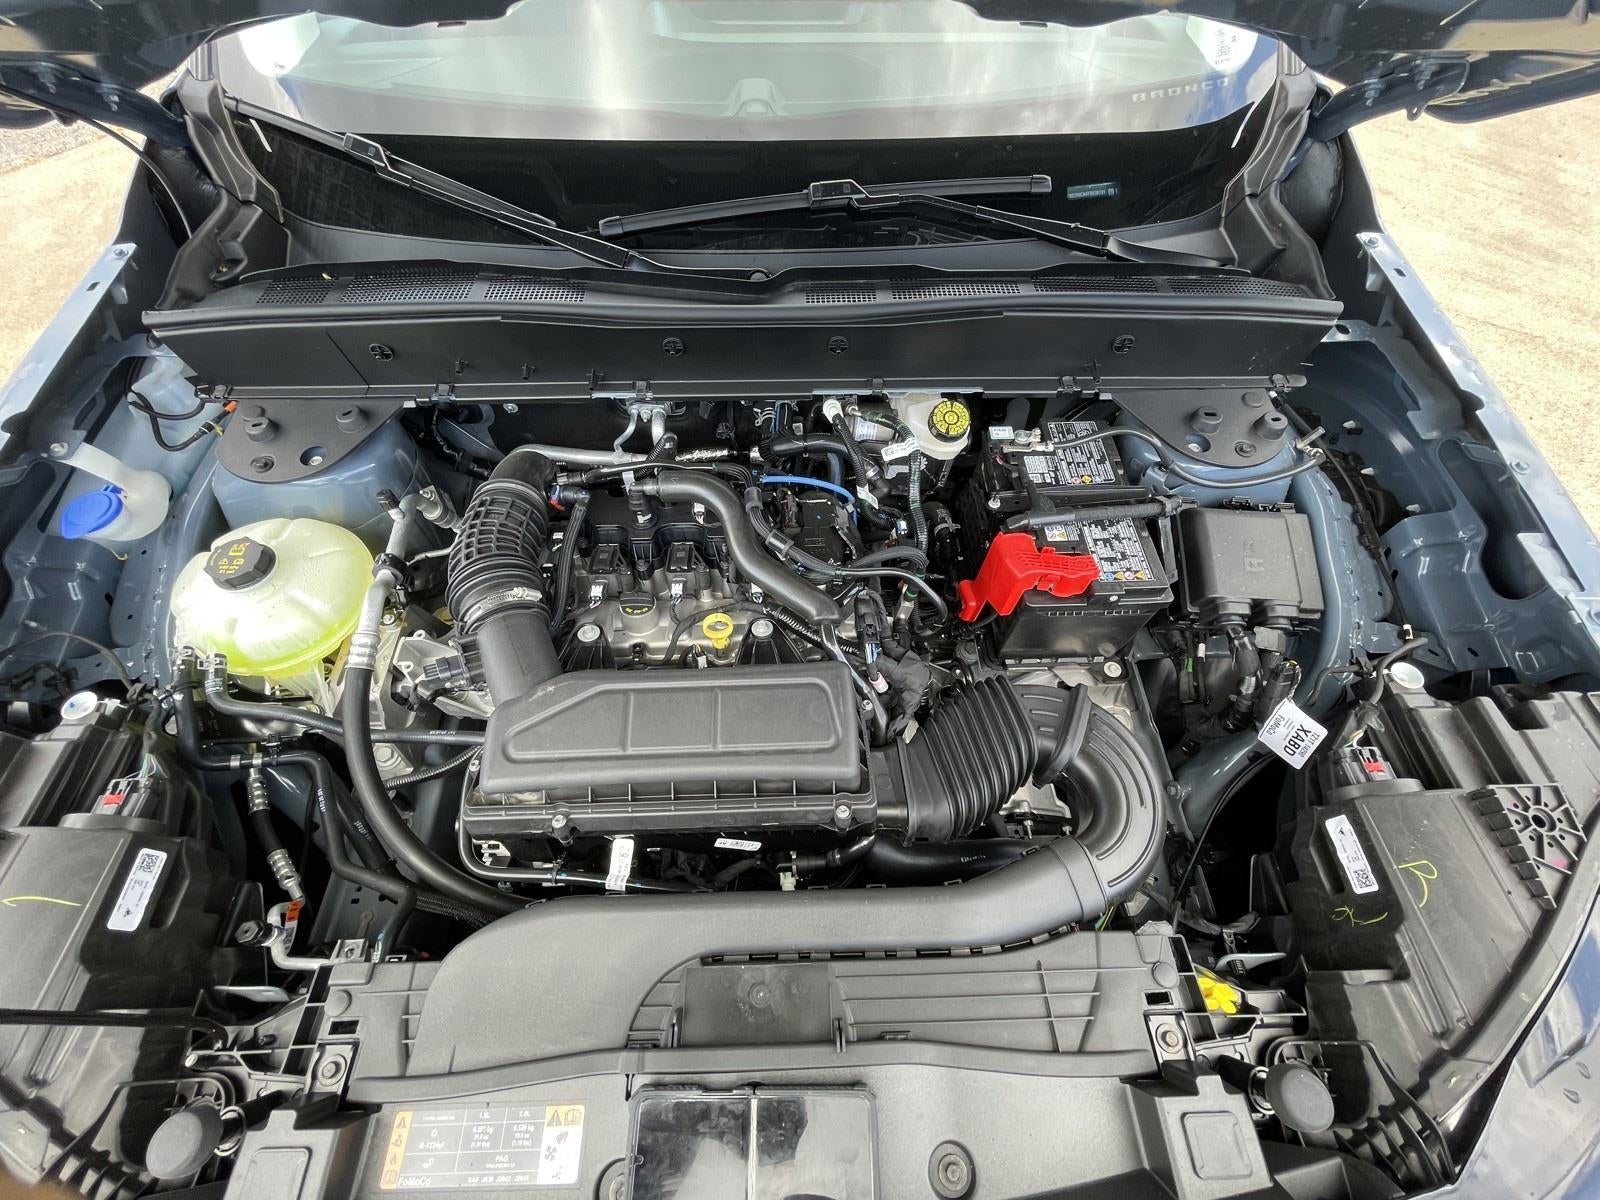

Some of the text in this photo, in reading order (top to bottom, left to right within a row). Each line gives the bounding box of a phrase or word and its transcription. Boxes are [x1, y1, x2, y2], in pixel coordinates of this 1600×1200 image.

[1132, 77, 1229, 102] BRONCO
[1266, 714, 1286, 736] FoMoCo
[1283, 724, 1312, 757] XABD
[398, 1176, 431, 1186] FoMoCo
